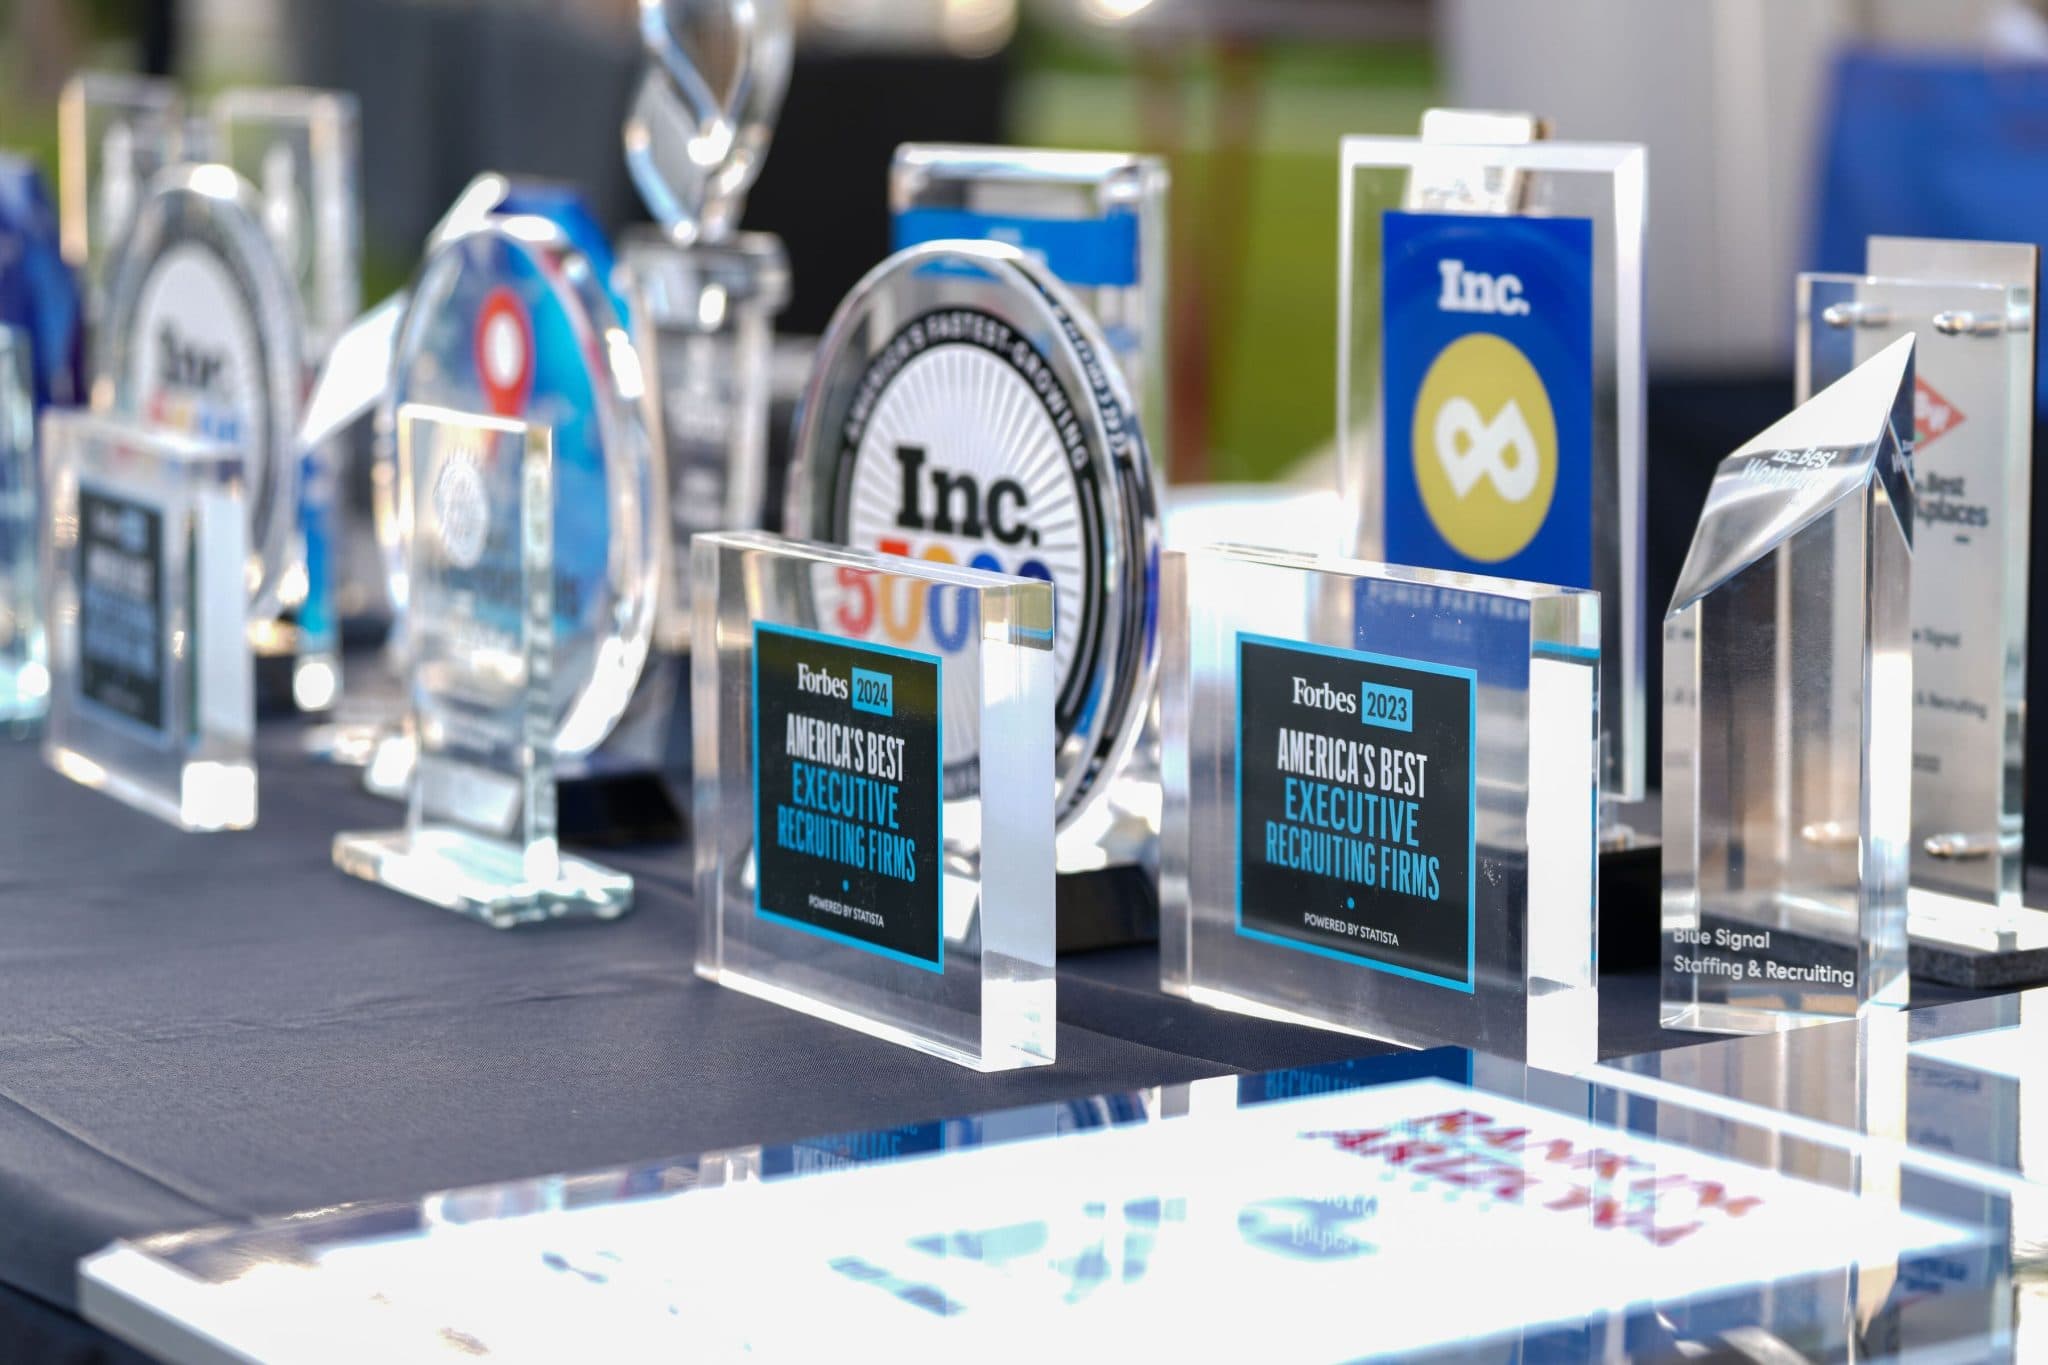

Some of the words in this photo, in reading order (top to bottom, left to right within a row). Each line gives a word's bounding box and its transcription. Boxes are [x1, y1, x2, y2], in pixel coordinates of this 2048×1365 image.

[1437, 259, 1530, 316] Inc.
[895, 446, 1041, 546] Inc.
[797, 662, 848, 700] Forbes
[857, 677, 889, 708] 2024
[1291, 676, 1357, 715] Forbes
[1367, 691, 1408, 722] 2023
[785, 713, 865, 772] AMERICA'S
[867, 731, 906, 782] BEST
[1277, 727, 1376, 789] AMERICA'S
[1380, 747, 1428, 798] BEST
[792, 761, 900, 830] EXECUTIVE
[1285, 777, 1420, 847] EXECUTIVE
[777, 804, 866, 869] RECRUITING
[868, 828, 916, 883] FIRMS
[1265, 820, 1376, 887] RECRUITING
[1380, 846, 1440, 901] FIRMS
[808, 893, 843, 916] POWERED
[843, 904, 853, 919] BY
[853, 907, 885, 928] STATISTA
[1304, 912, 1346, 934] POWERED
[1347, 922, 1359, 936] BY
[1360, 926, 1400, 947] STATISTA
[1673, 928, 1712, 944] Blue
[1715, 928, 1770, 951] Signal
[1673, 954, 1743, 981] Staffing
[1747, 959, 1762, 978] &
[1766, 960, 1855, 988] Recruiting
